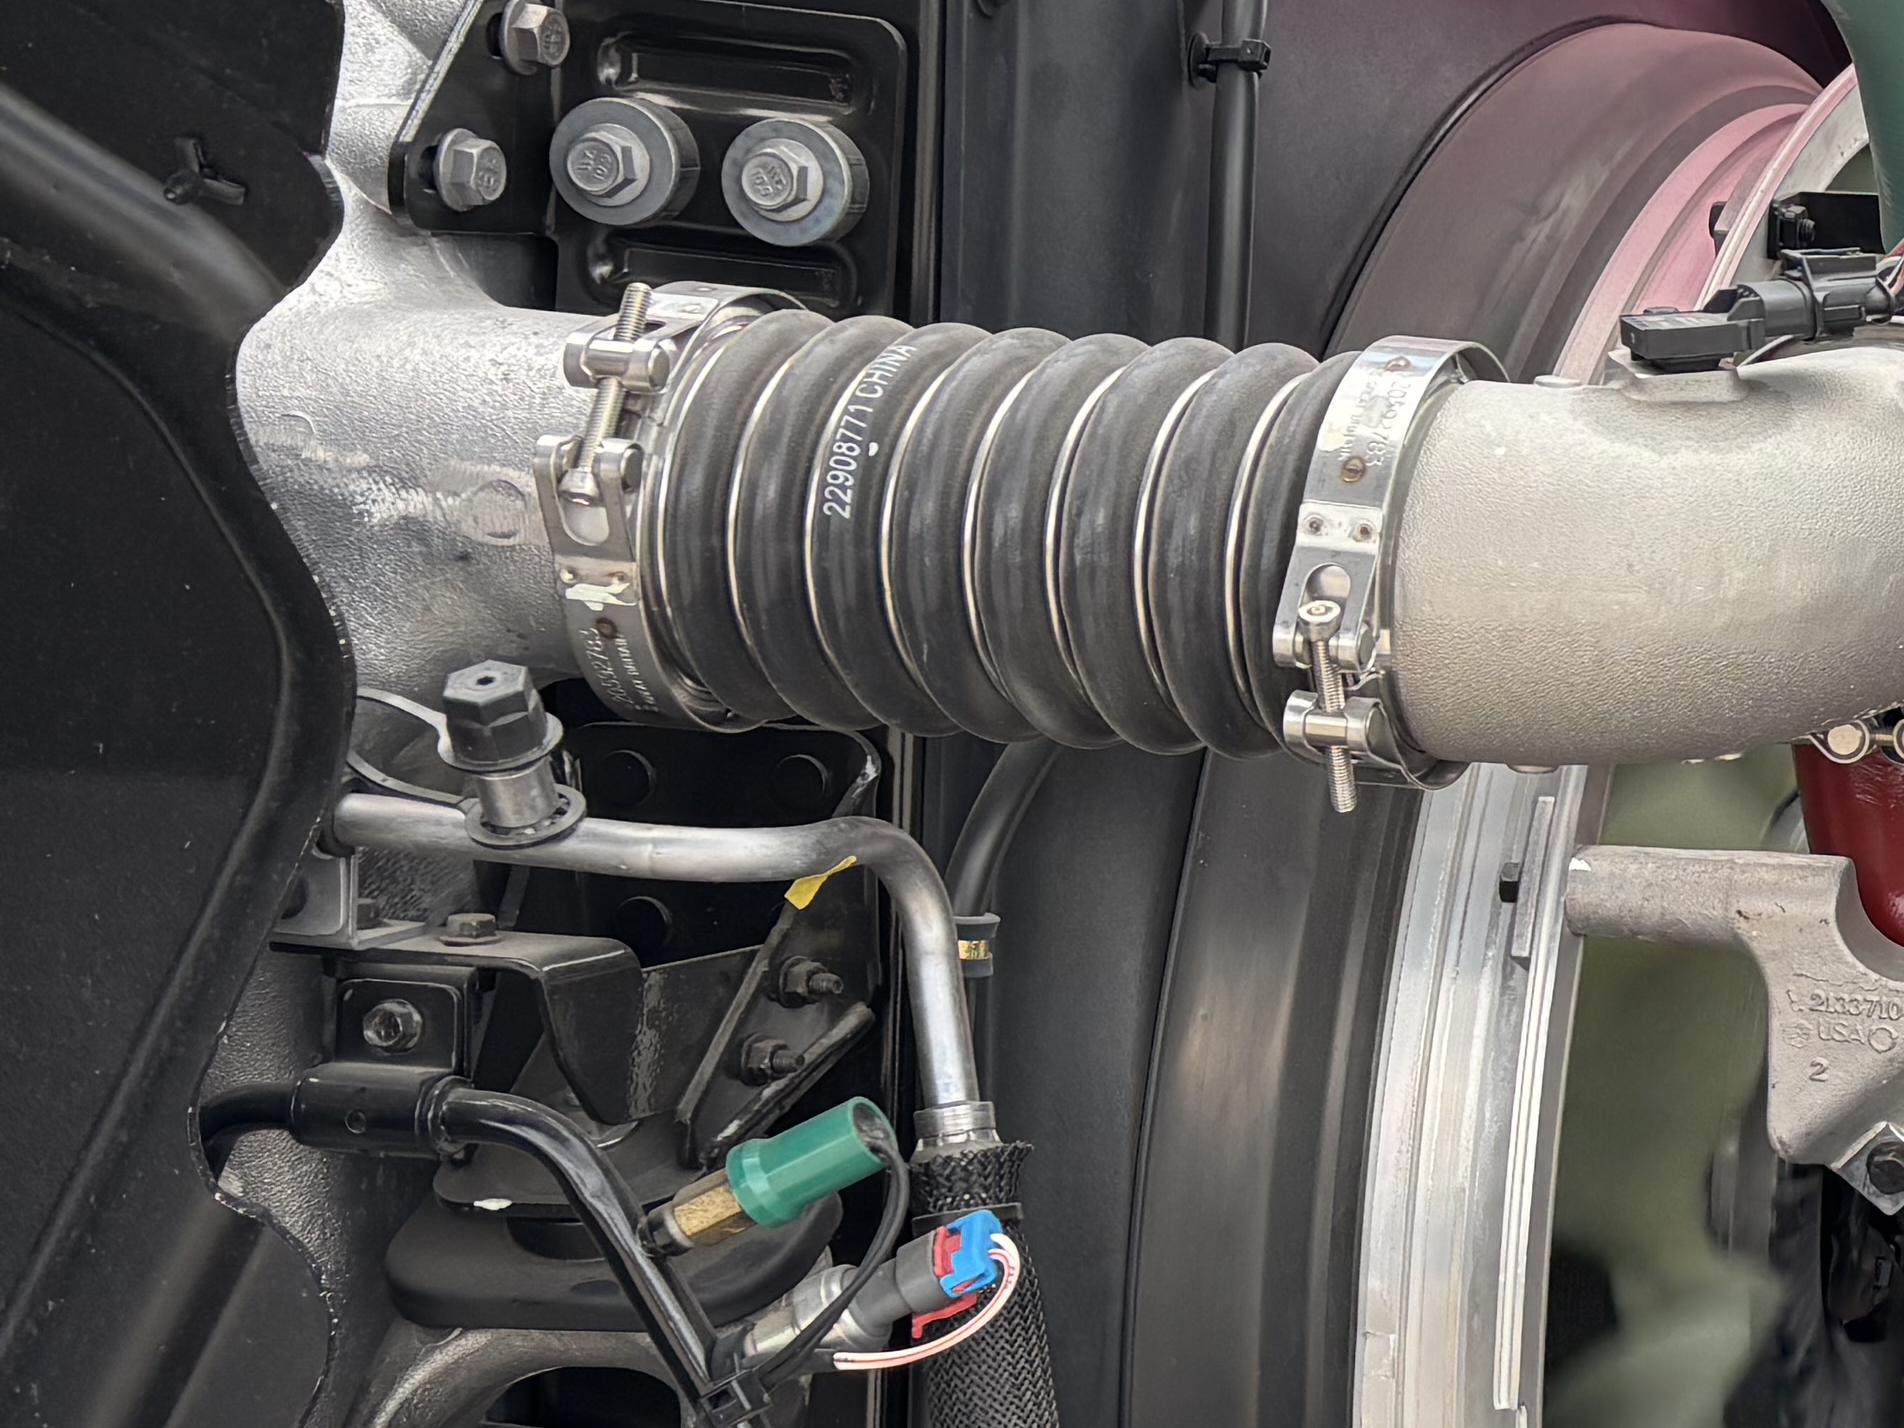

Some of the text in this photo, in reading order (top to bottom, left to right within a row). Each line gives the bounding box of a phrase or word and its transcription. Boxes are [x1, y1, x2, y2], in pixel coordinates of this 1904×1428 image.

[822, 342, 918, 520] 22908771 CHINA
[1817, 1022, 1865, 1045] USA
[1809, 1057, 1829, 1082] 2
